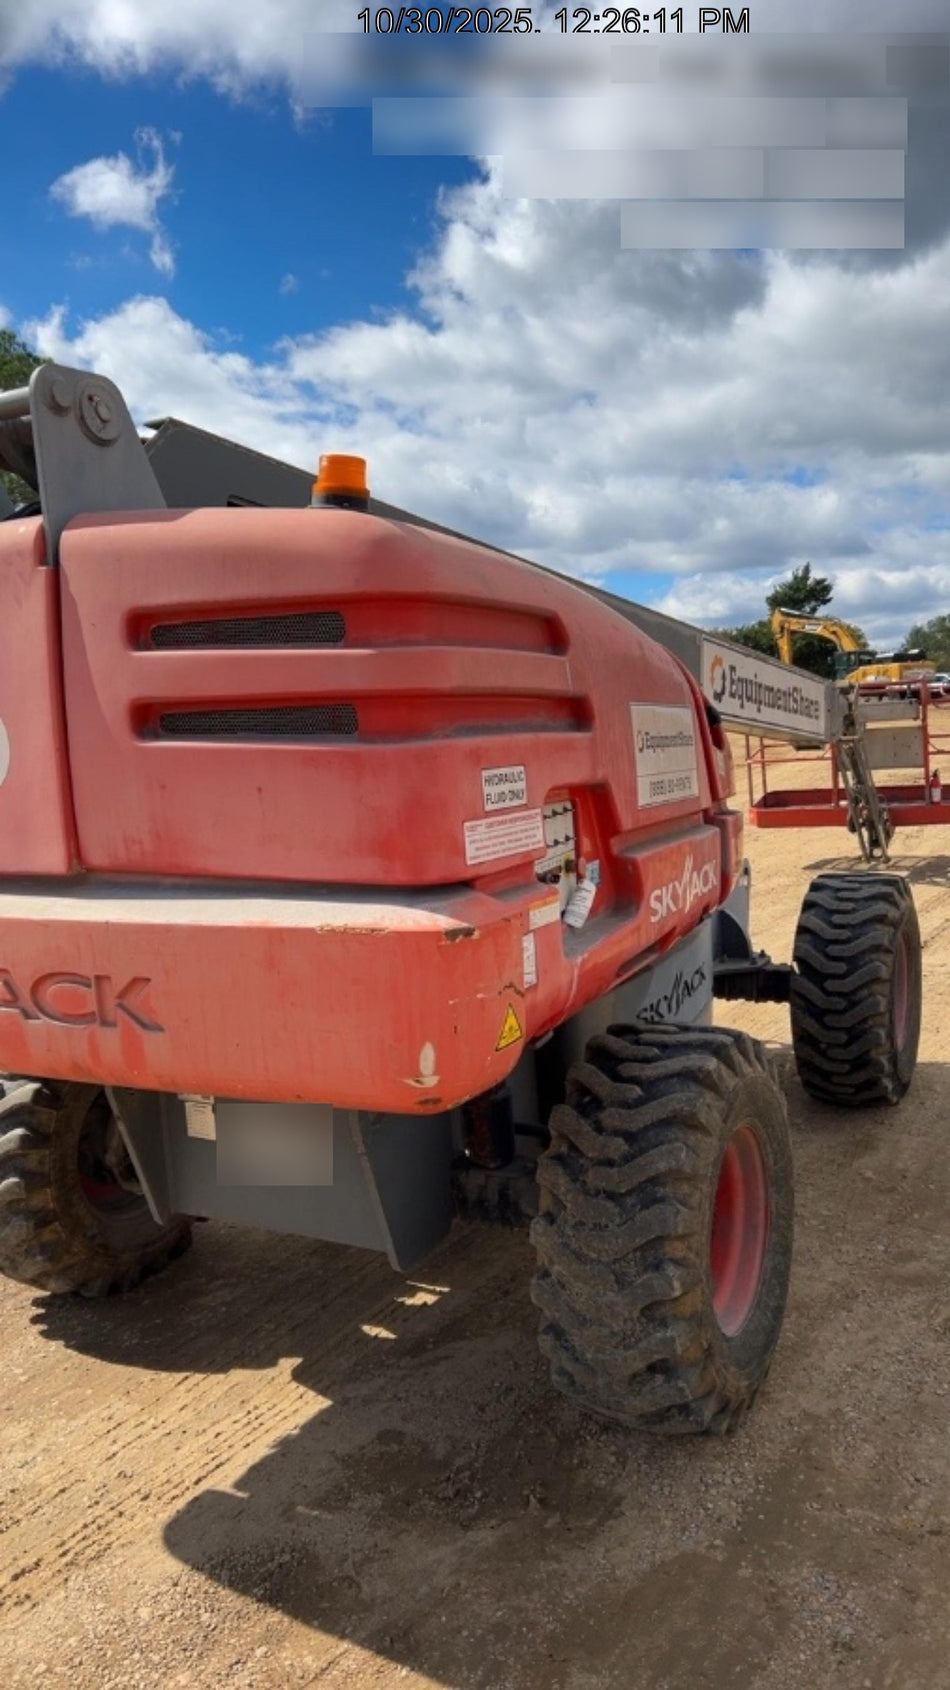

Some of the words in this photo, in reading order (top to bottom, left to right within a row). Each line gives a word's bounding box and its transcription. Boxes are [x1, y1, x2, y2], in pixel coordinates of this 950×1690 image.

[728, 664, 819, 720] EquipmentShare
[484, 771, 524, 786] HYDRAULIC
[486, 791, 506, 805] FLUID
[508, 789, 525, 801] ONLY
[649, 854, 717, 923] SKYJACK
[636, 962, 706, 1023] SKYJACK
